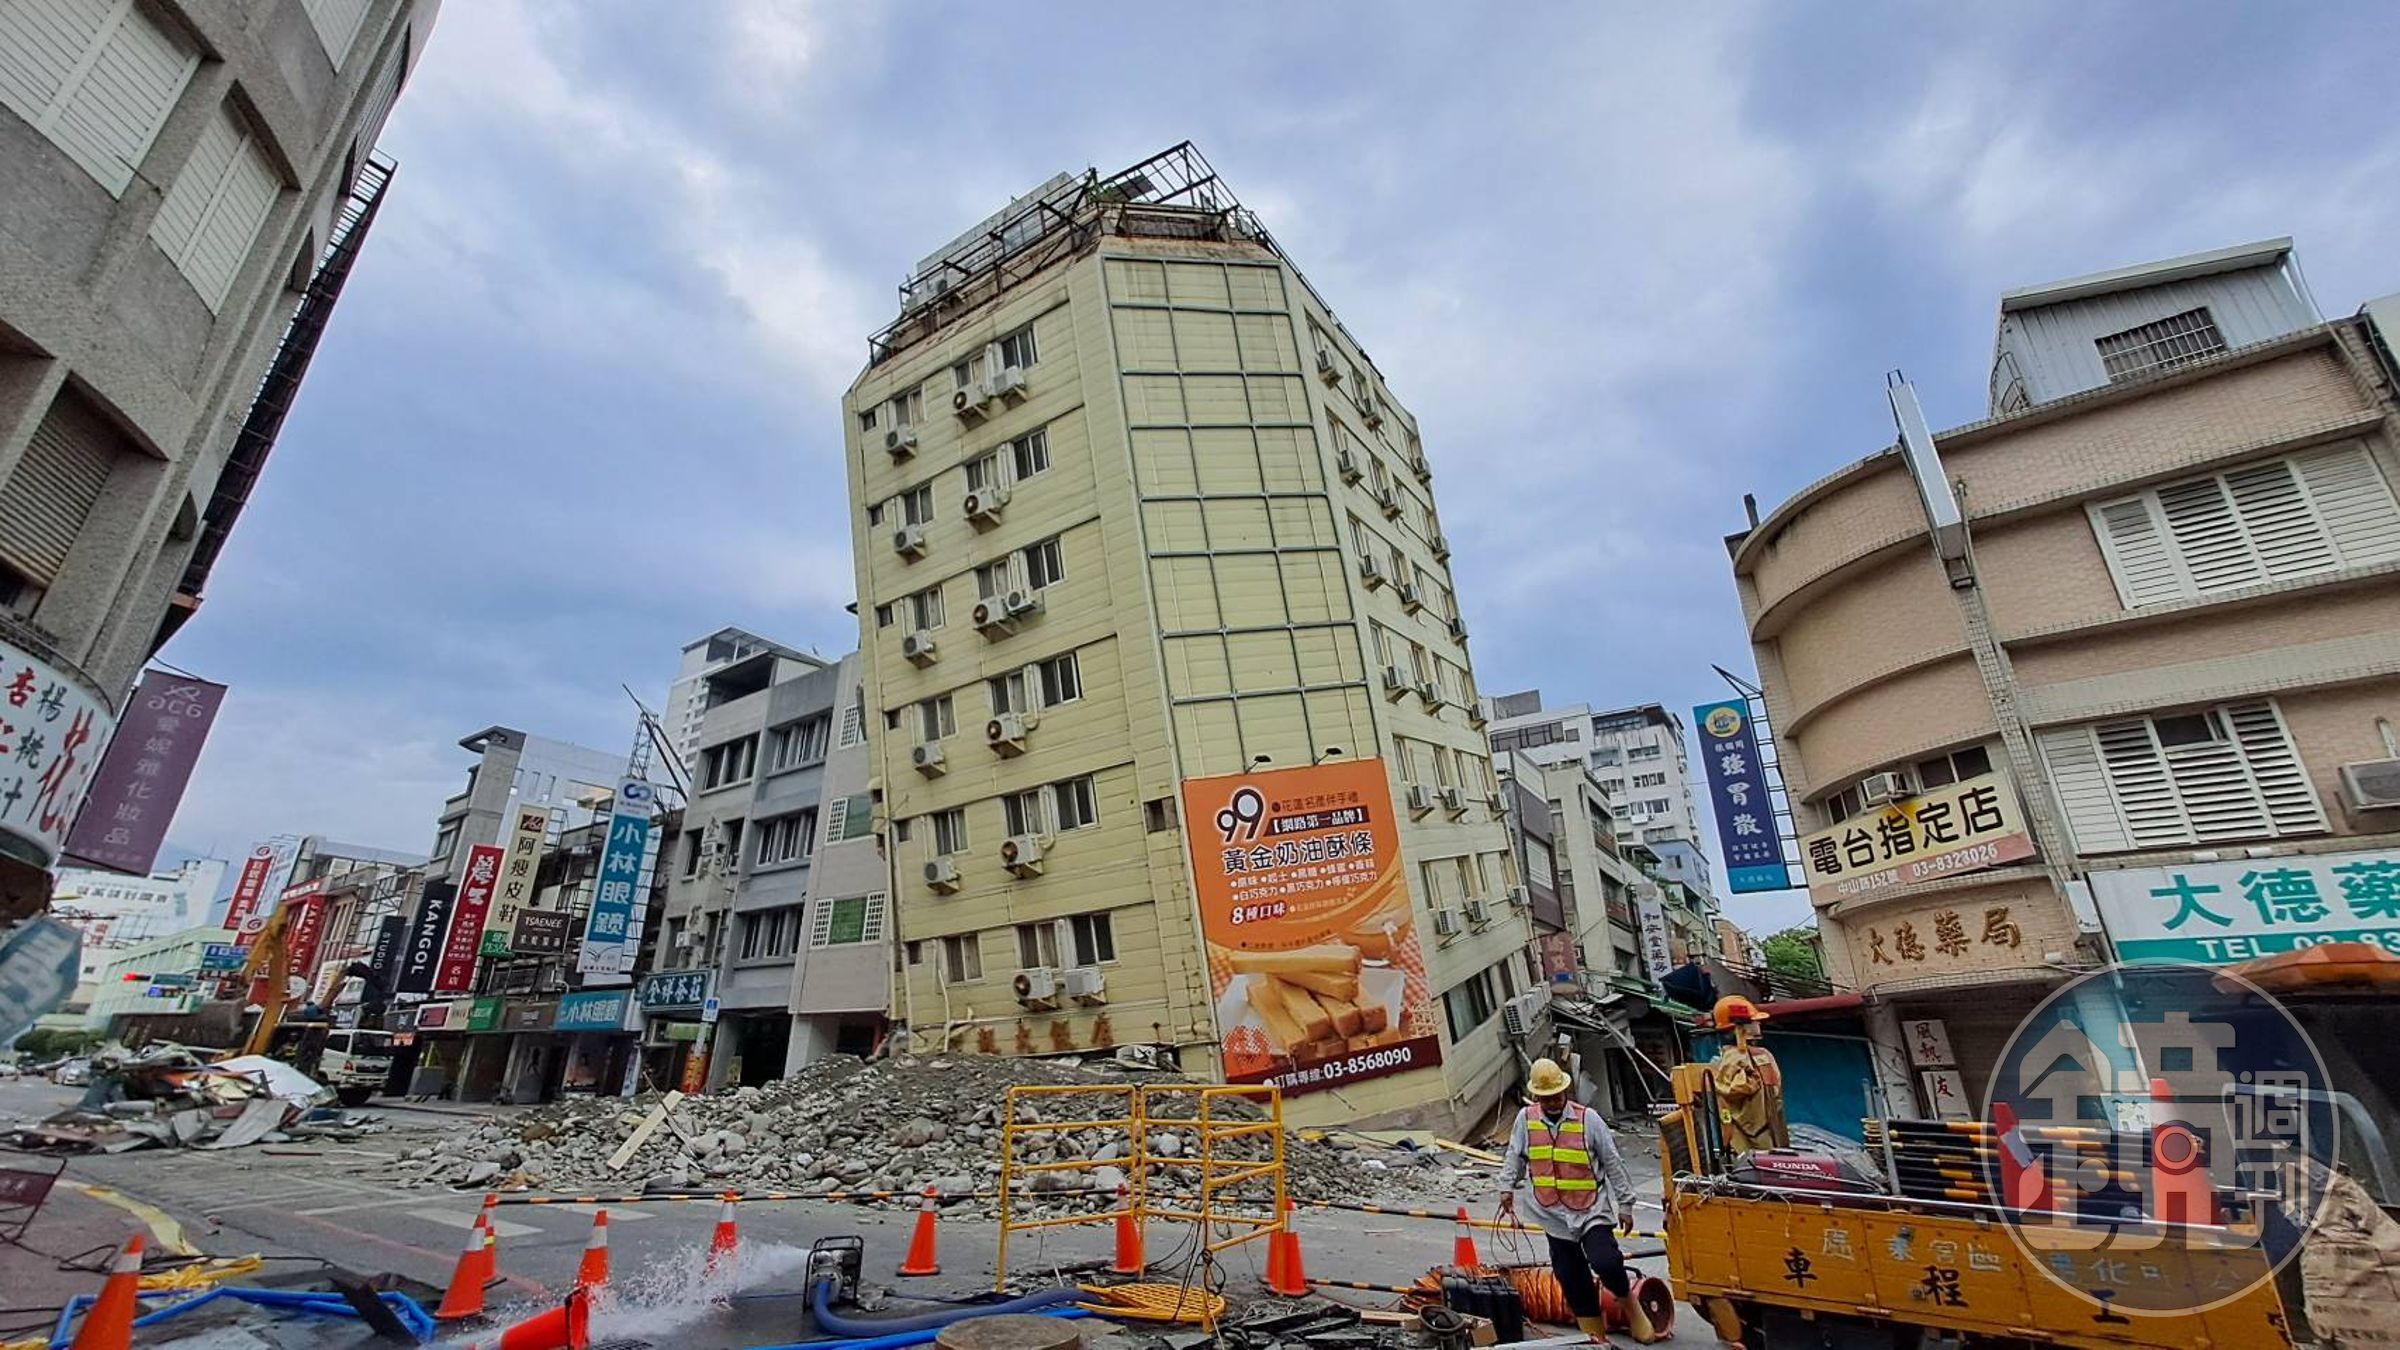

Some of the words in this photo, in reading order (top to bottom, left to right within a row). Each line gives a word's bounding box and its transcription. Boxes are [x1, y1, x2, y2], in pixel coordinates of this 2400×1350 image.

[1216, 788, 1264, 842] 99
[1721, 753, 1763, 836] 強胃散
[1222, 830, 1373, 874] 黃金奶油酥條
[1809, 786, 2003, 875] 電台指定店
[498, 836, 536, 924] 阿瘦皮鞋
[593, 822, 641, 936] 小林眼鏡
[410, 899, 443, 976] KANGOL
[1869, 907, 2022, 965] 大德藥局
[2196, 936, 2280, 960] TEL
[1323, 1047, 1412, 1079] 03-8568090
[1772, 1161, 1821, 1171] HONDA
